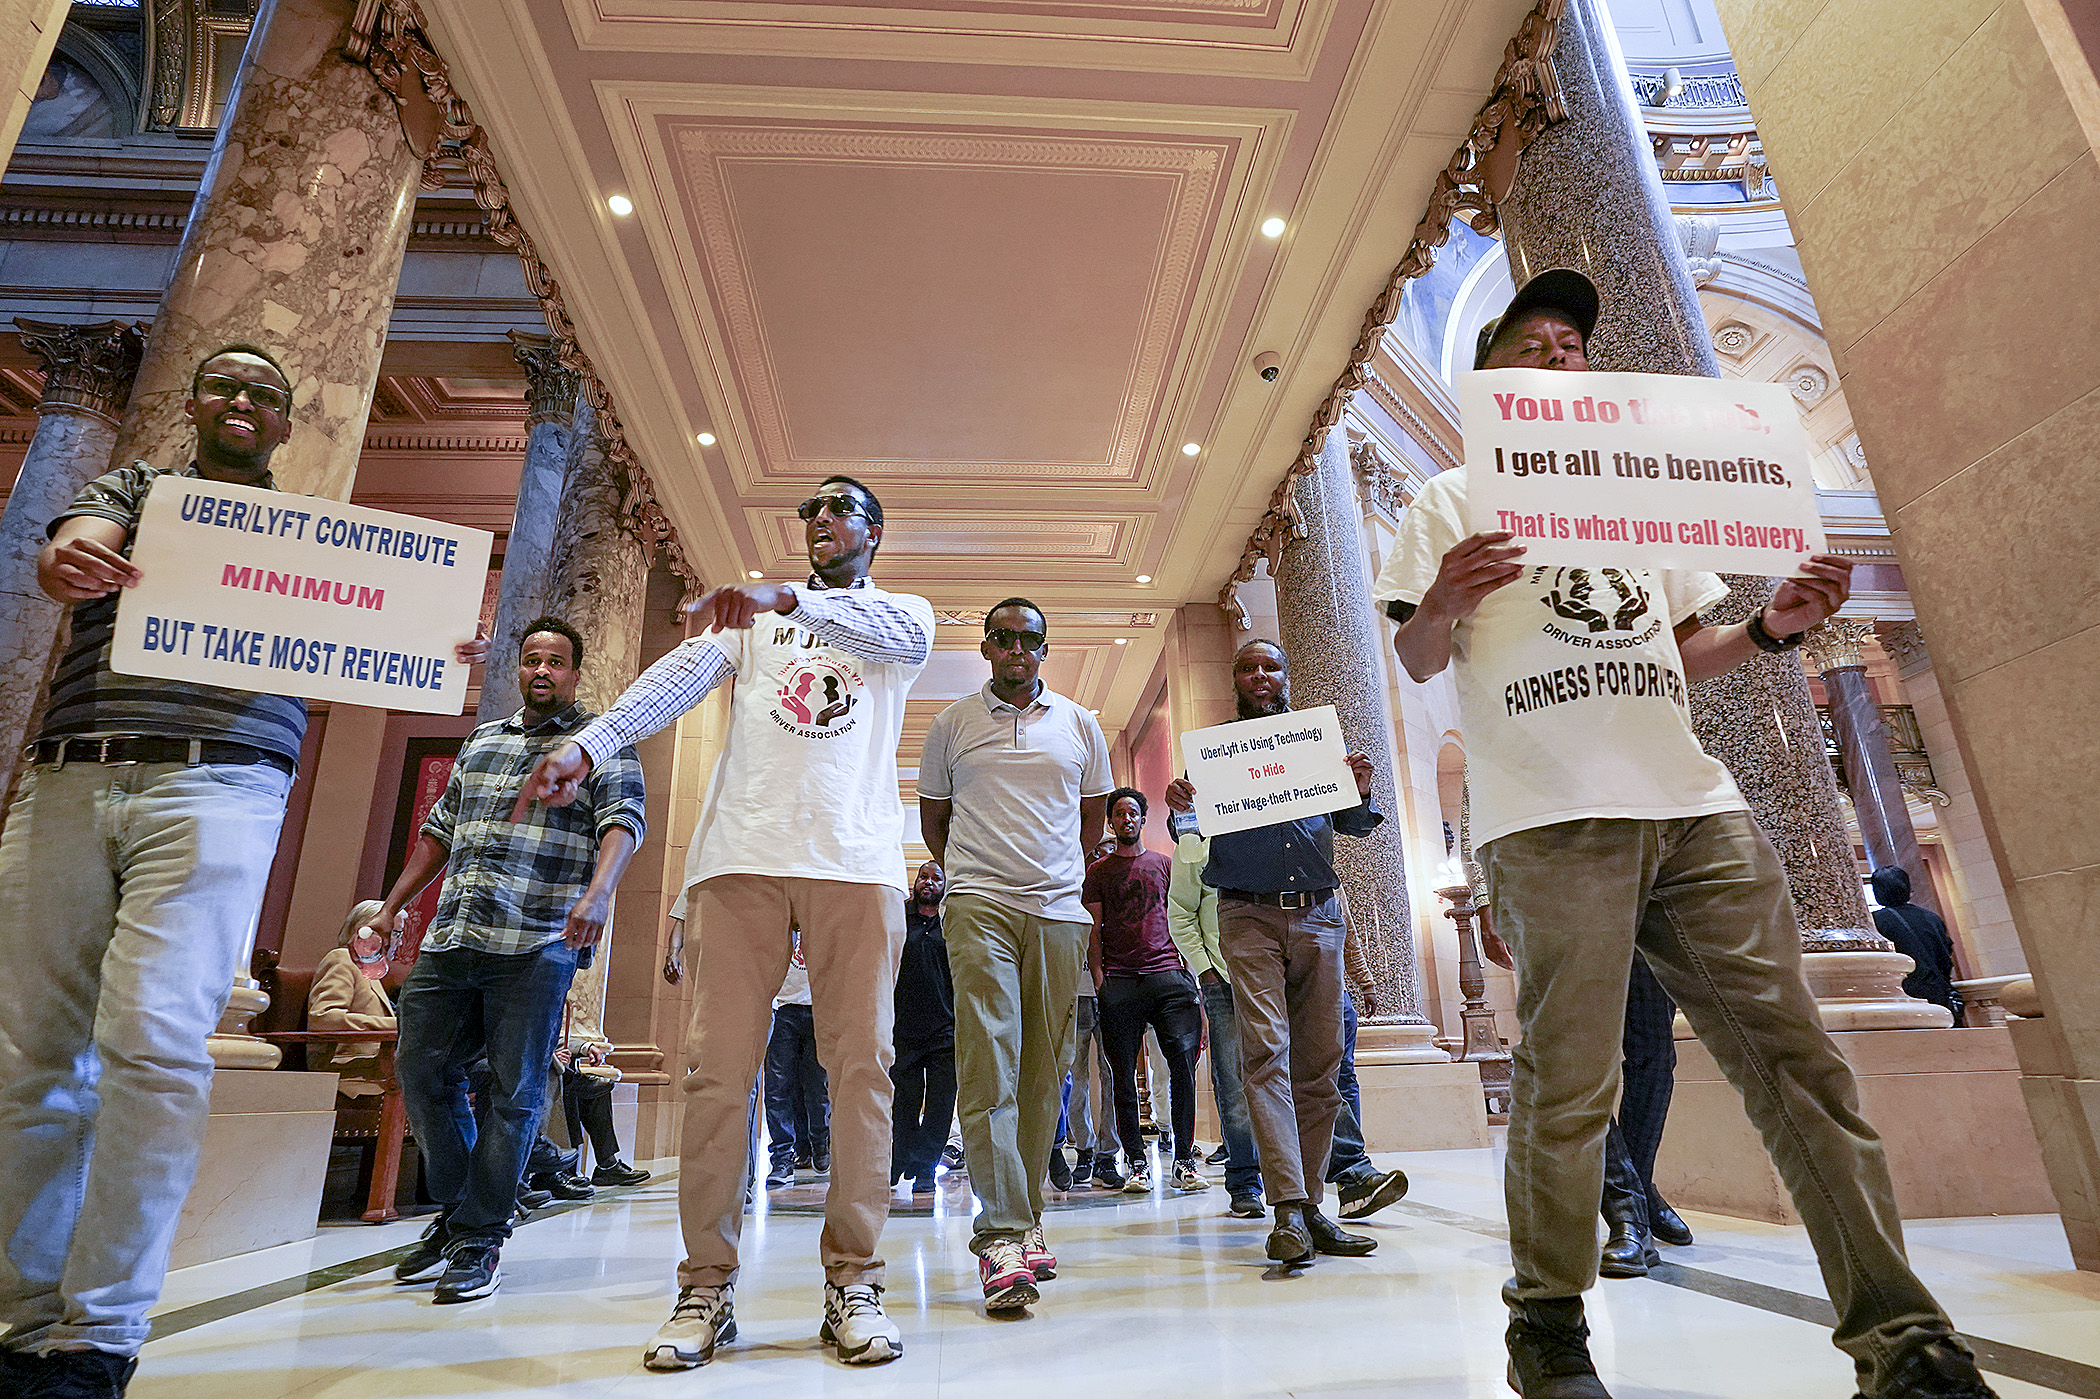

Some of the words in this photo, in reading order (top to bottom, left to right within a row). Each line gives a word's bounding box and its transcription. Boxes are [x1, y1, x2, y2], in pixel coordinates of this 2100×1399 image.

[1493, 393, 1564, 422] You
[1572, 396, 1621, 424] do
[1495, 448, 1505, 473] I
[1512, 450, 1559, 477] get
[1565, 450, 1601, 476] all
[1613, 452, 1659, 480] the
[1665, 453, 1791, 488] benefits,
[181, 494, 310, 540] UBER/LYFT
[316, 516, 458, 567] CONTRIBUTE
[1497, 510, 1545, 538] That
[1549, 512, 1569, 539] is
[1574, 515, 1627, 541] what
[1632, 521, 1673, 545] you
[1678, 519, 1719, 545] call
[1725, 521, 1810, 553] slavery.
[221, 564, 385, 611] MINIMUM
[1542, 622, 1591, 649] DRIVER
[1595, 618, 1662, 649] ASSOCIATION
[143, 616, 195, 655] BUT
[203, 624, 264, 666] TAKE
[269, 635, 336, 675] MOST
[341, 646, 446, 690] REVENUE
[1505, 664, 1590, 717] FAIRNESS
[1595, 661, 1631, 696] FOR
[1634, 662, 1685, 708] DRIER
[769, 709, 796, 733] DRIVER
[797, 718, 857, 739] ASSOCIATION
[1200, 741, 1239, 760] Uber/Lyft
[1240, 740, 1248, 753] is
[1250, 736, 1275, 751] Using
[1274, 726, 1323, 746] Technology
[1248, 767, 1261, 780] To
[1263, 763, 1286, 778] Hide
[1215, 801, 1240, 816] Their
[1241, 790, 1292, 811] Wage-theft
[1293, 782, 1338, 800] Practices
